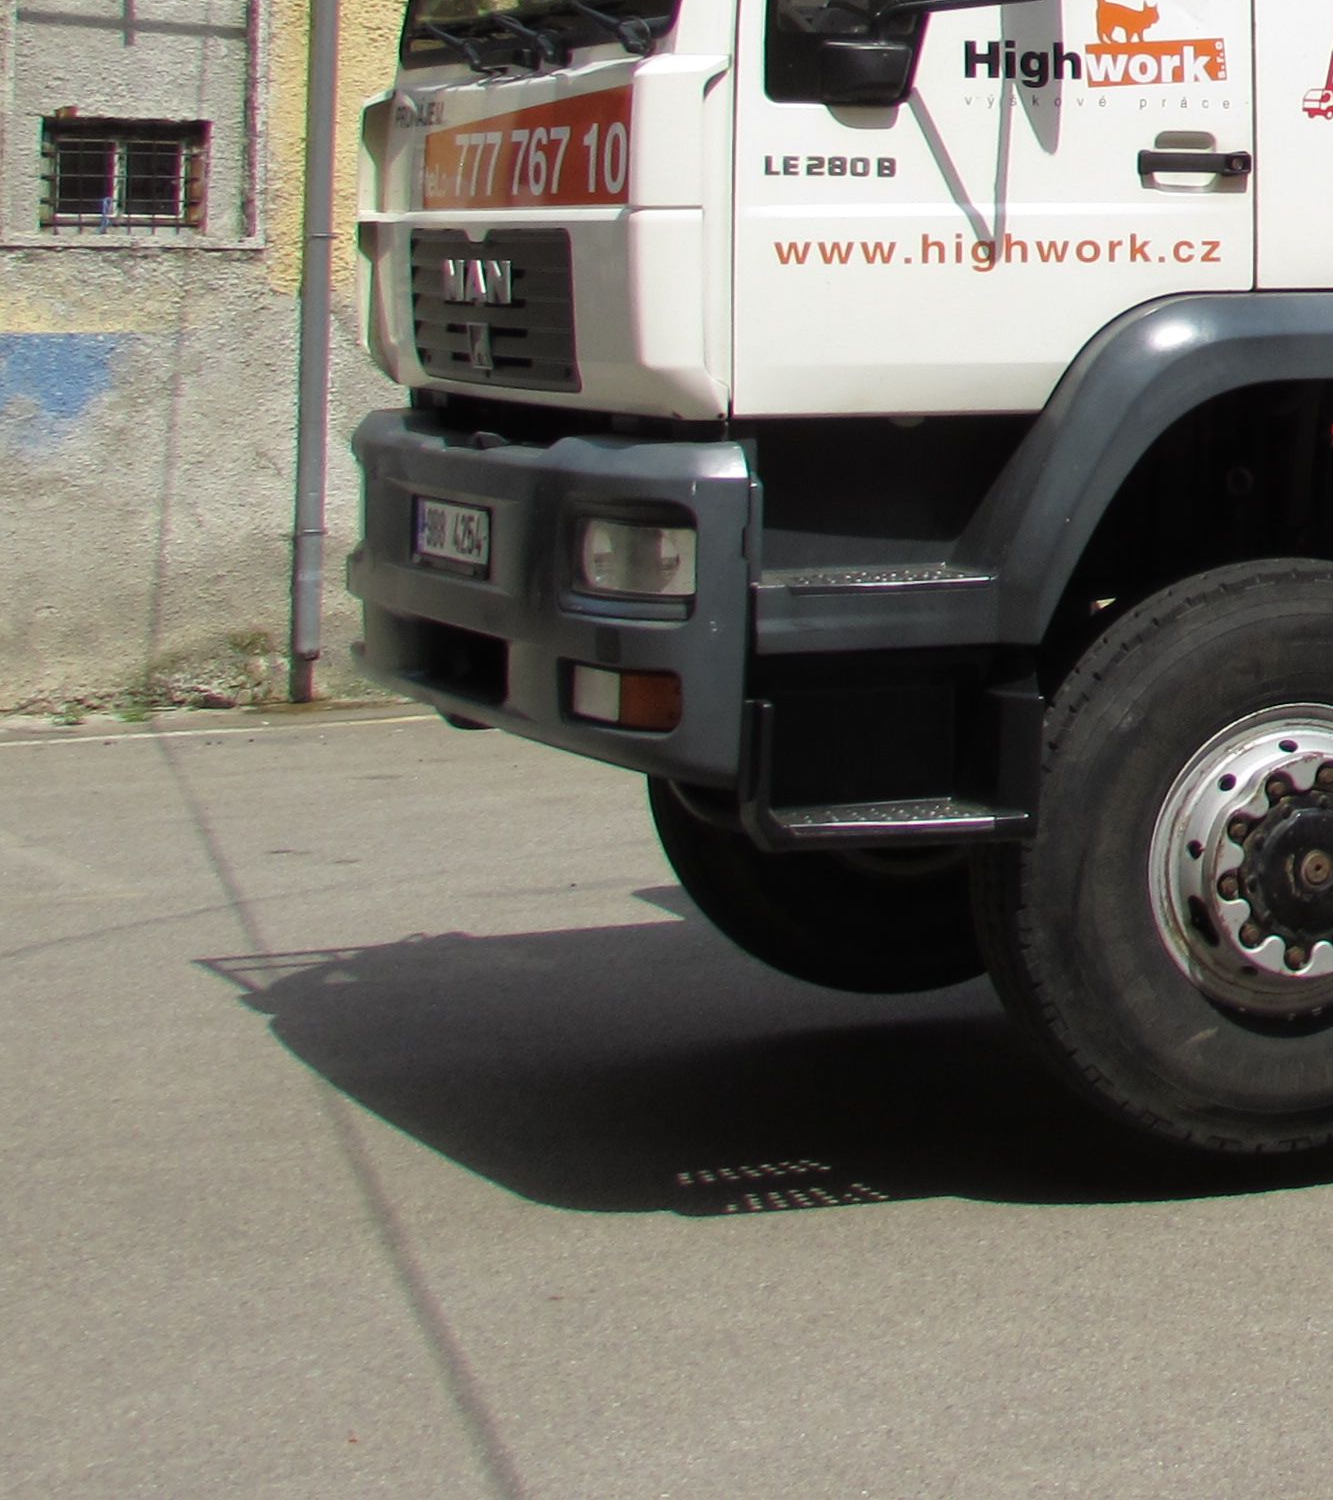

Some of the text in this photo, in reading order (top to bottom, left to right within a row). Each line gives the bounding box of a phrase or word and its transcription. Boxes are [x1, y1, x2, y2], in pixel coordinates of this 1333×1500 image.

[964, 40, 1212, 88] Highwork
[455, 131, 503, 197] 777
[511, 125, 571, 197] 767
[764, 155, 897, 178] LE 280 B
[773, 233, 1222, 272] www.highwork.cz
